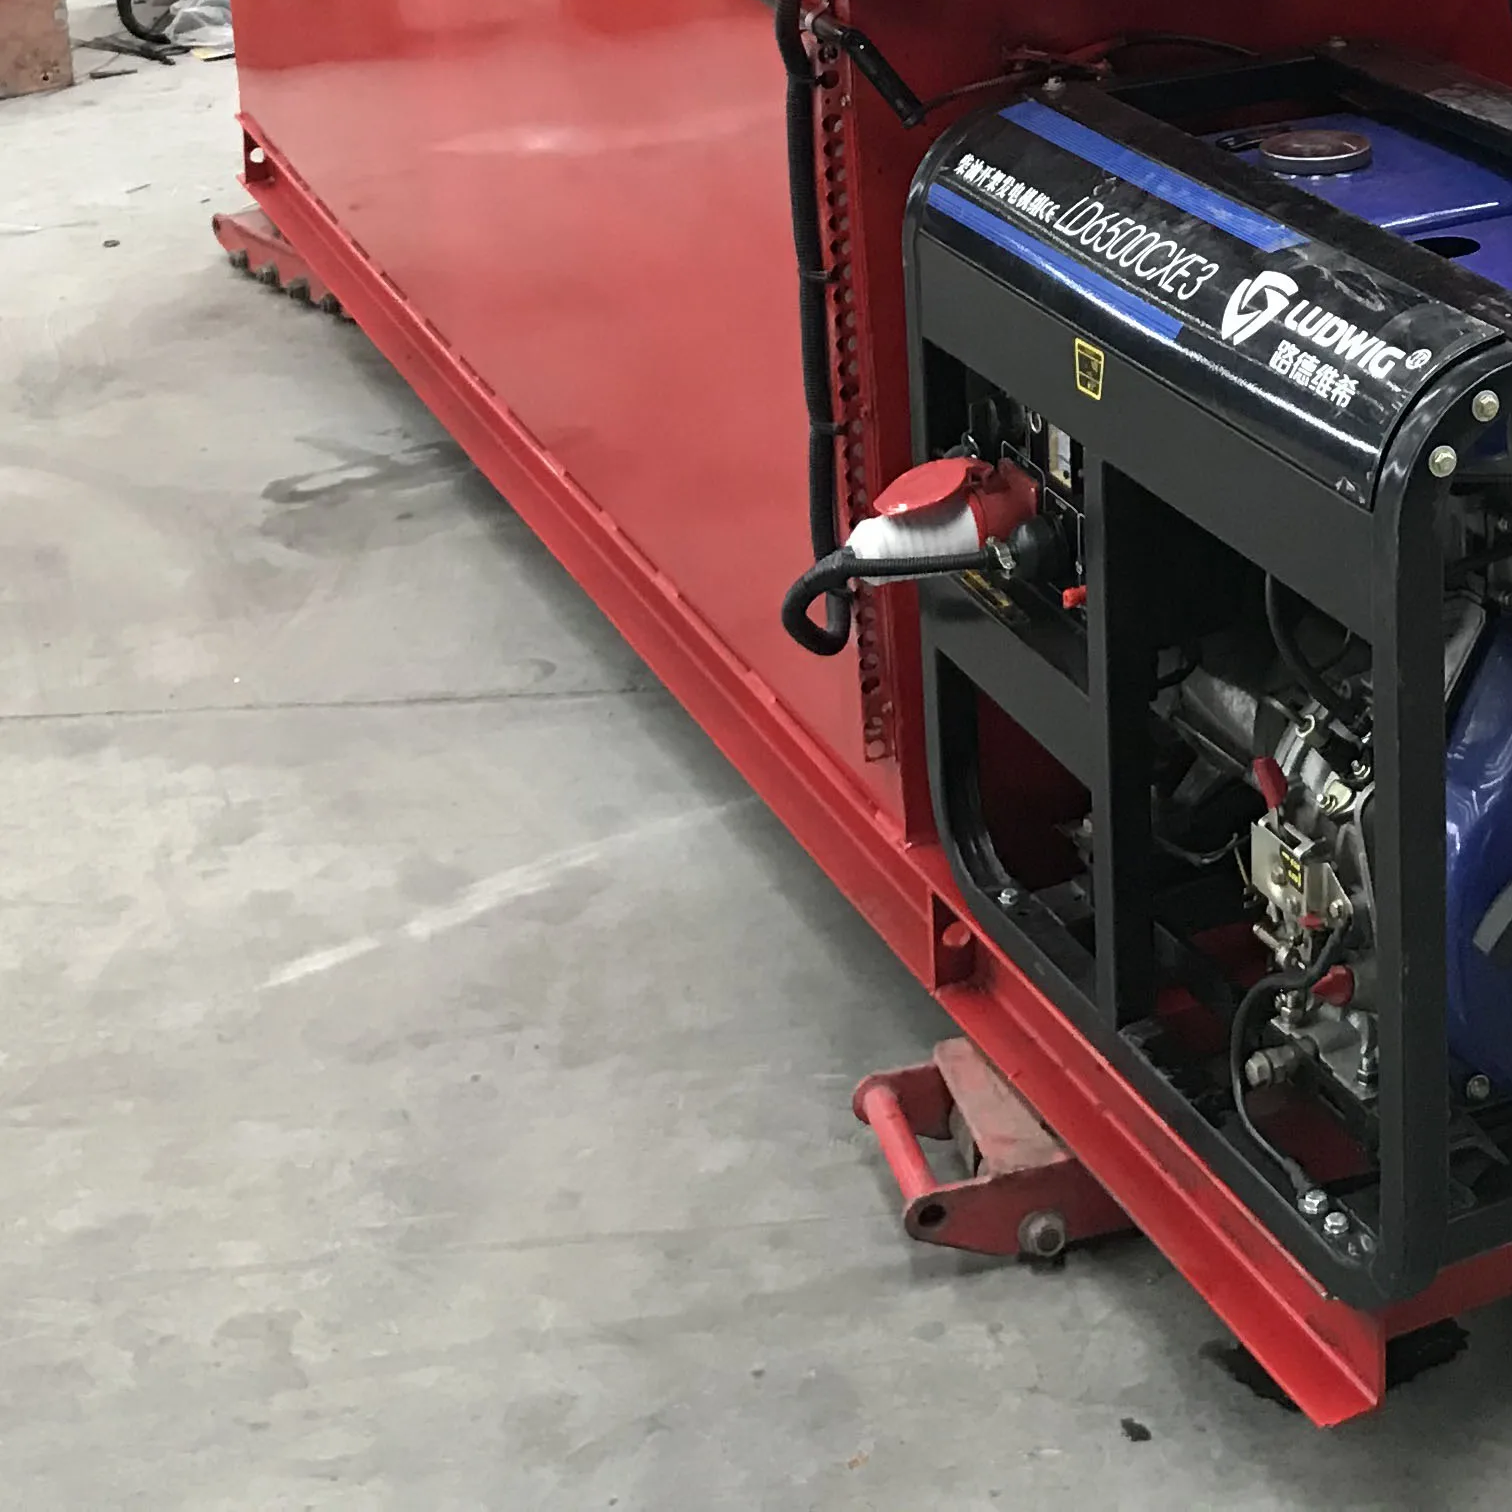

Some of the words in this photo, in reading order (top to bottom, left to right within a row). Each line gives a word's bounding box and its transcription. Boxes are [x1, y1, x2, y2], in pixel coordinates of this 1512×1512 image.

[1053, 196, 1220, 301] LD6500CXE3
[1269, 339, 1360, 408] 路德维希
[1284, 299, 1407, 380] LUDWIG
